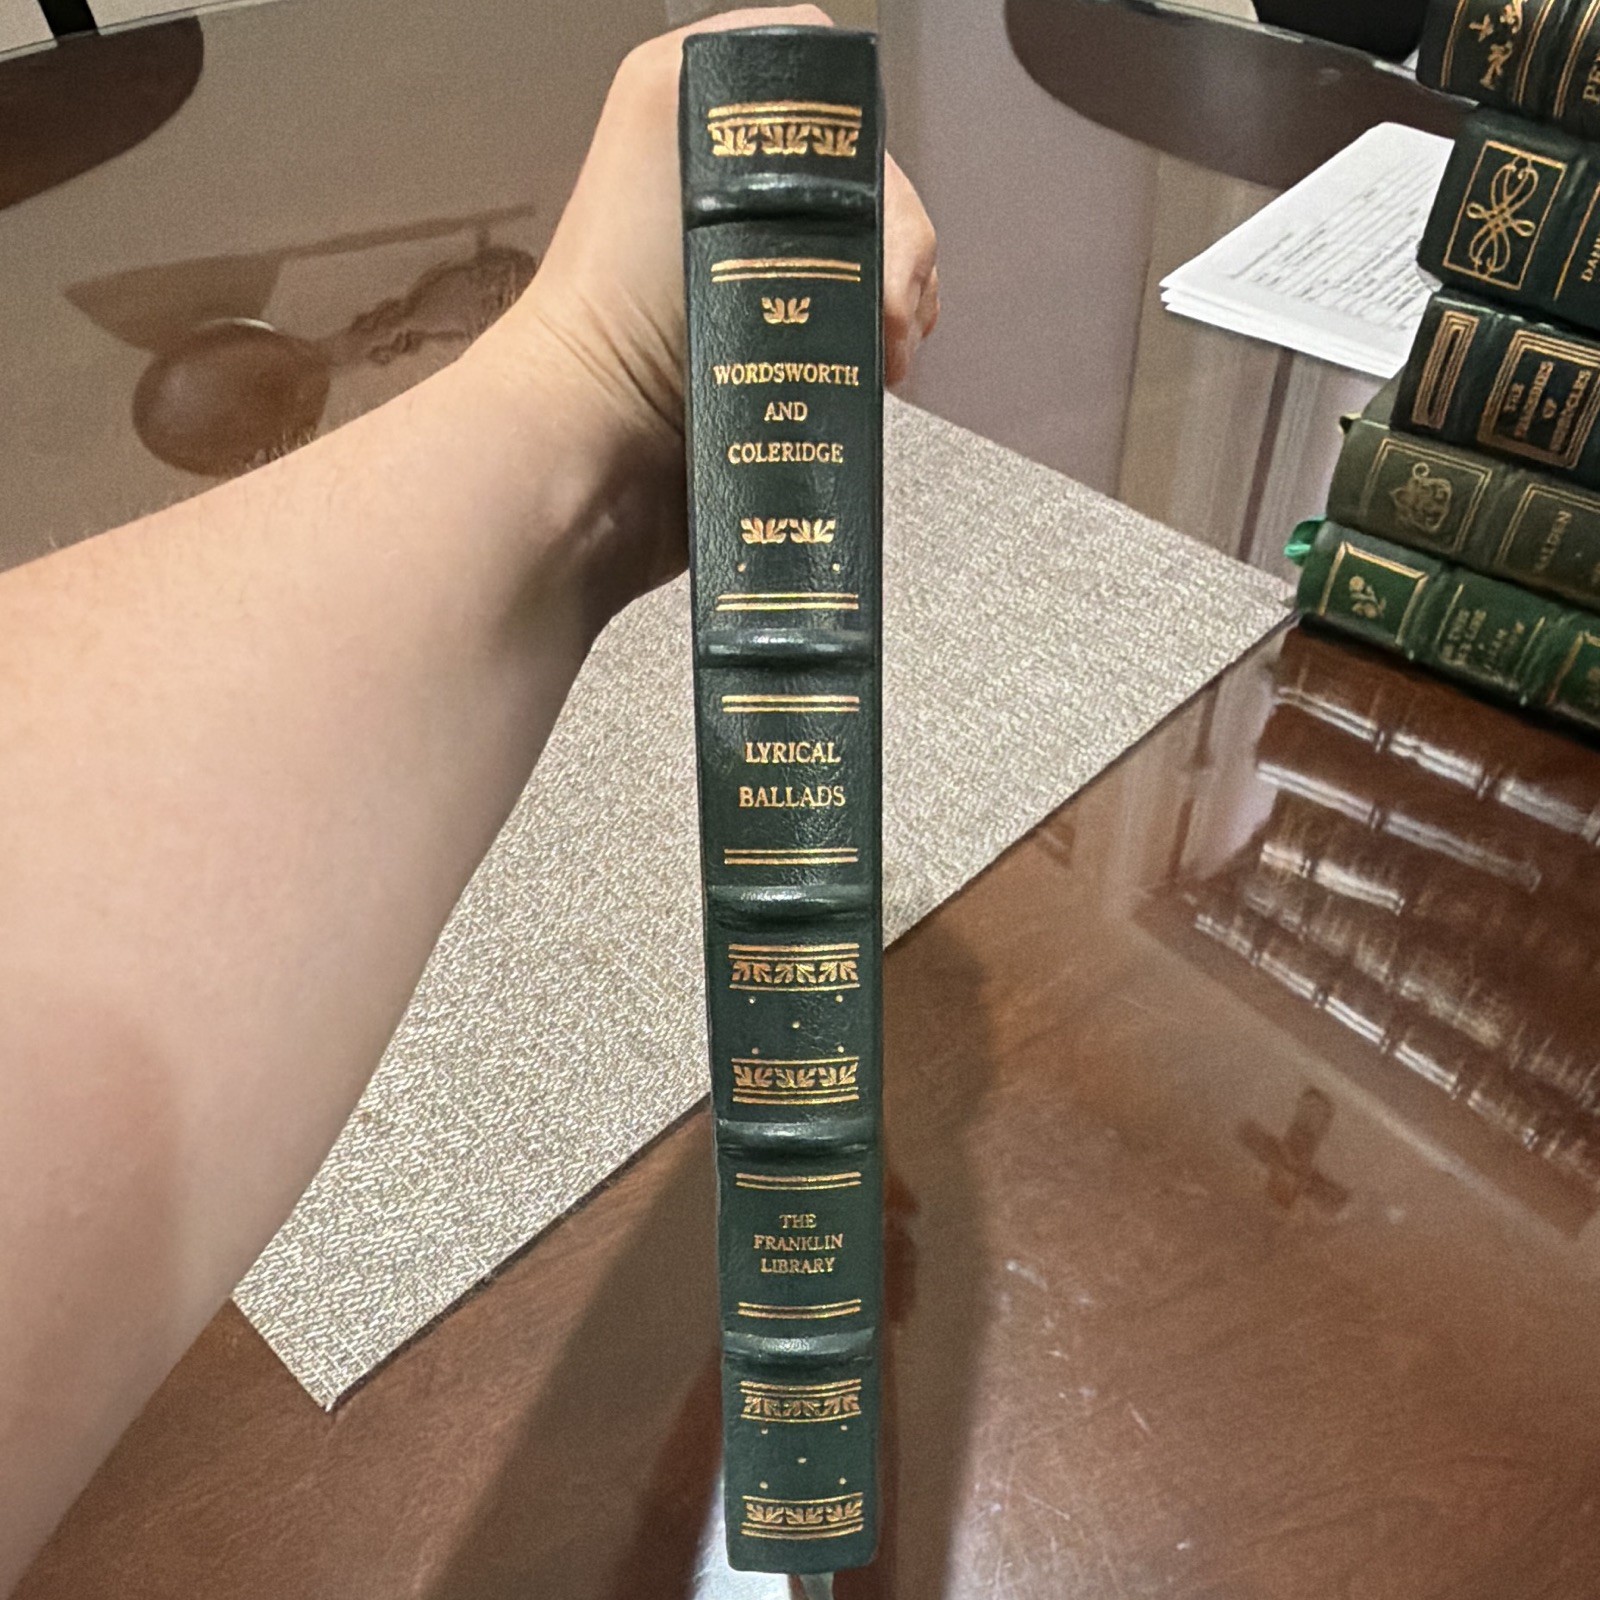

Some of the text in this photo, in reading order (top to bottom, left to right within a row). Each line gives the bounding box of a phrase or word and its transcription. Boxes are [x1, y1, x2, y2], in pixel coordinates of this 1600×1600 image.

[713, 362, 859, 386] WORDSWORTH
[764, 402, 808, 422] AND
[728, 442, 844, 464] COLERIDGE
[745, 741, 841, 764] LYRICAL
[739, 785, 846, 808] BALLADS
[779, 1213, 817, 1229] THE
[753, 1233, 843, 1251] FRANKLIN
[760, 1257, 836, 1274] LIBRARY
